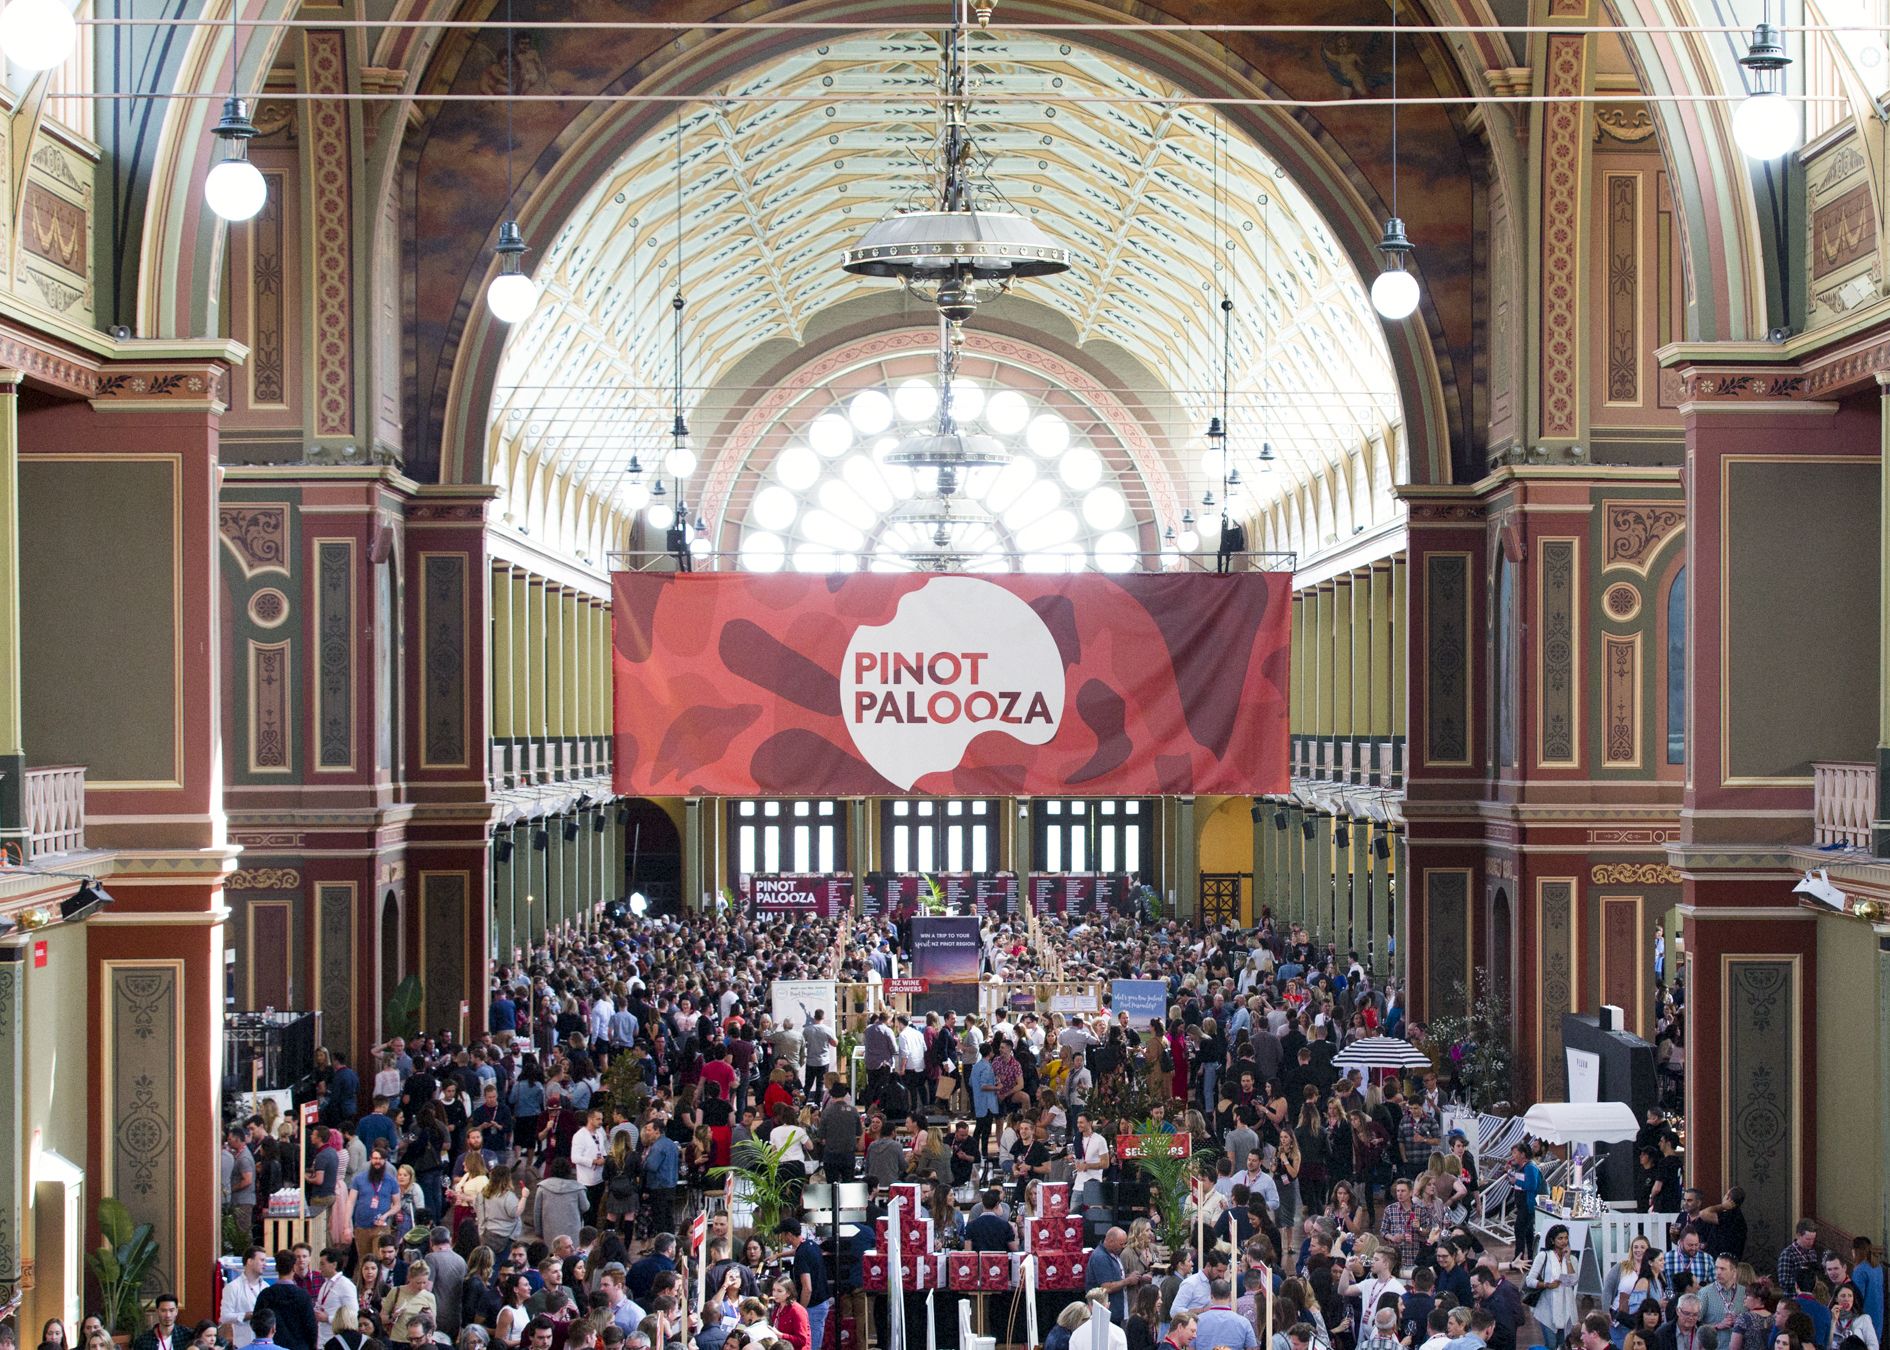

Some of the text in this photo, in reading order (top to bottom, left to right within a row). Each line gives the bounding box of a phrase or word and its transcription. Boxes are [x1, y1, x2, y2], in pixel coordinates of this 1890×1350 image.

[855, 652, 989, 685] PINOT
[855, 691, 1054, 724] PALOOZA
[756, 881, 796, 892] PINOT
[756, 892, 816, 903] PALOOZA
